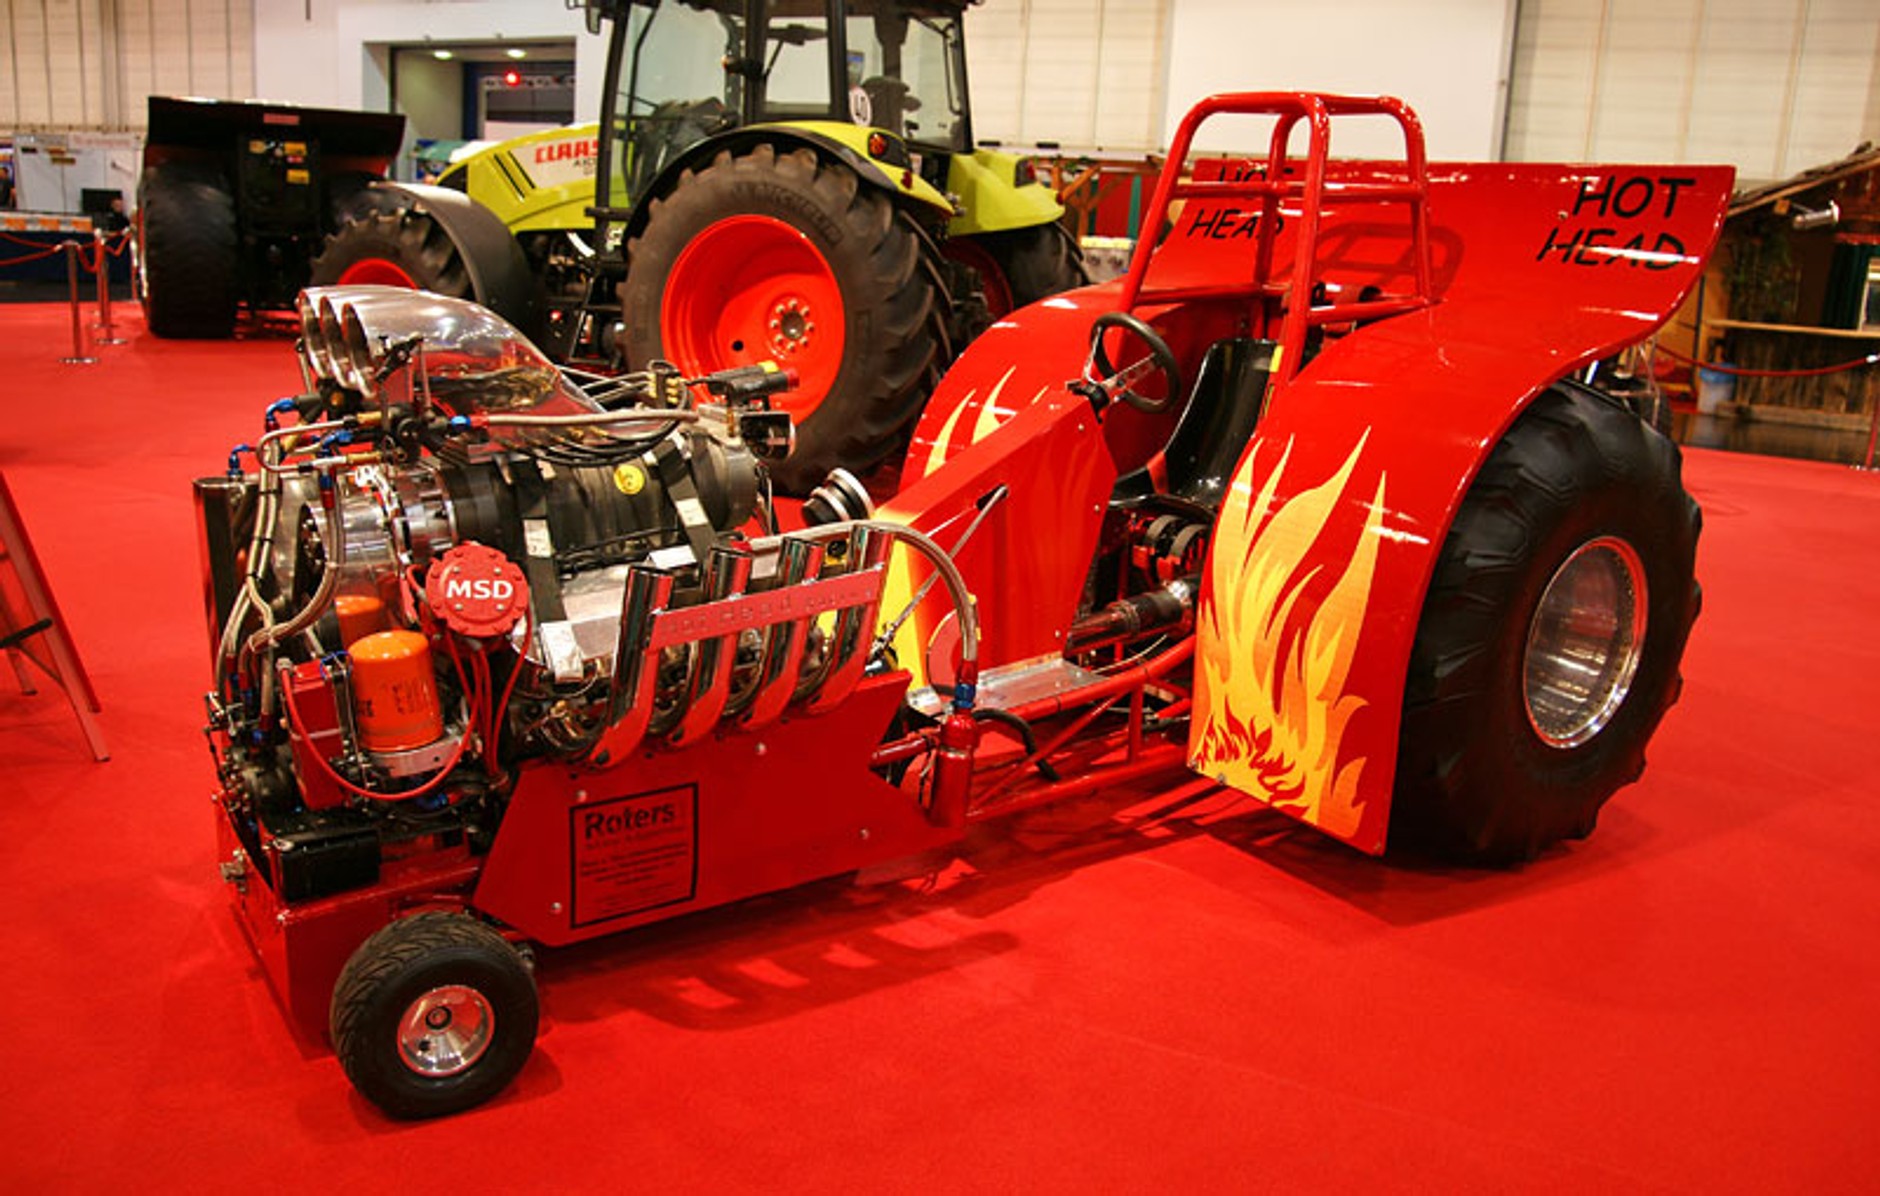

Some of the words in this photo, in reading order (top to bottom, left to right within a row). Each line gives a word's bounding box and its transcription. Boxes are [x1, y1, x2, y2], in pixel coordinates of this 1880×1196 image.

[1573, 175, 1696, 218] HOT
[1536, 228, 1685, 270] HEAD
[446, 579, 513, 600] MSD
[585, 803, 675, 840] Roters
